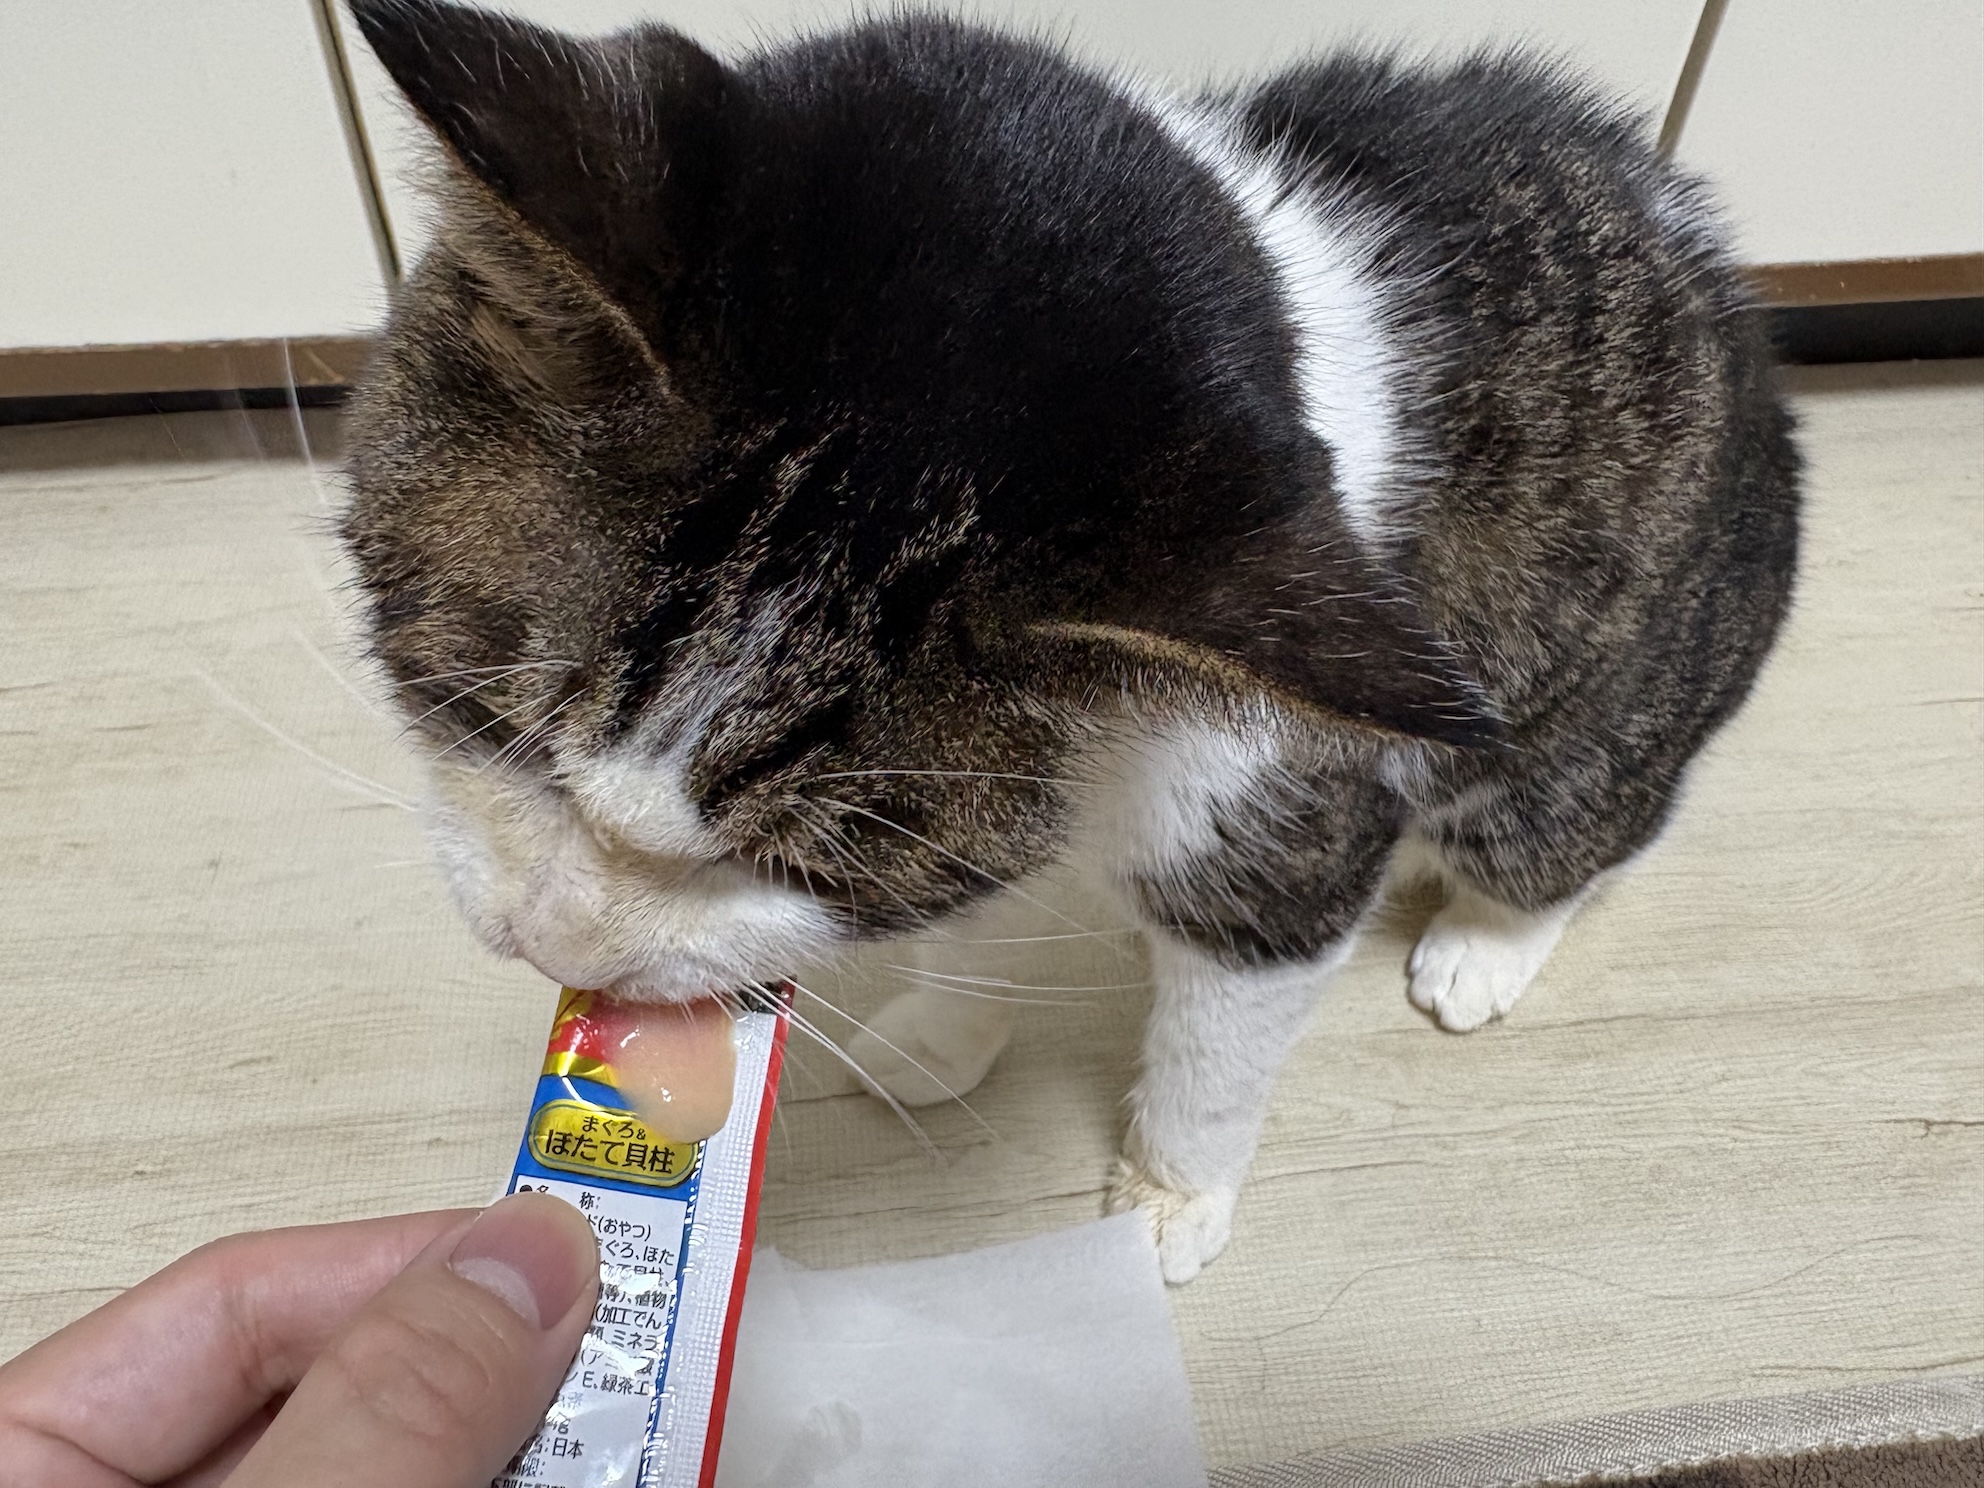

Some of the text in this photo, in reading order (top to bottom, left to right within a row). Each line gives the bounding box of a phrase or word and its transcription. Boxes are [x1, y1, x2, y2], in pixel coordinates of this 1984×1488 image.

[581, 1115, 647, 1140] まぐろ&
[545, 1129, 676, 1175] ほたて貝柱
[595, 1302, 662, 1330] (加工でん
